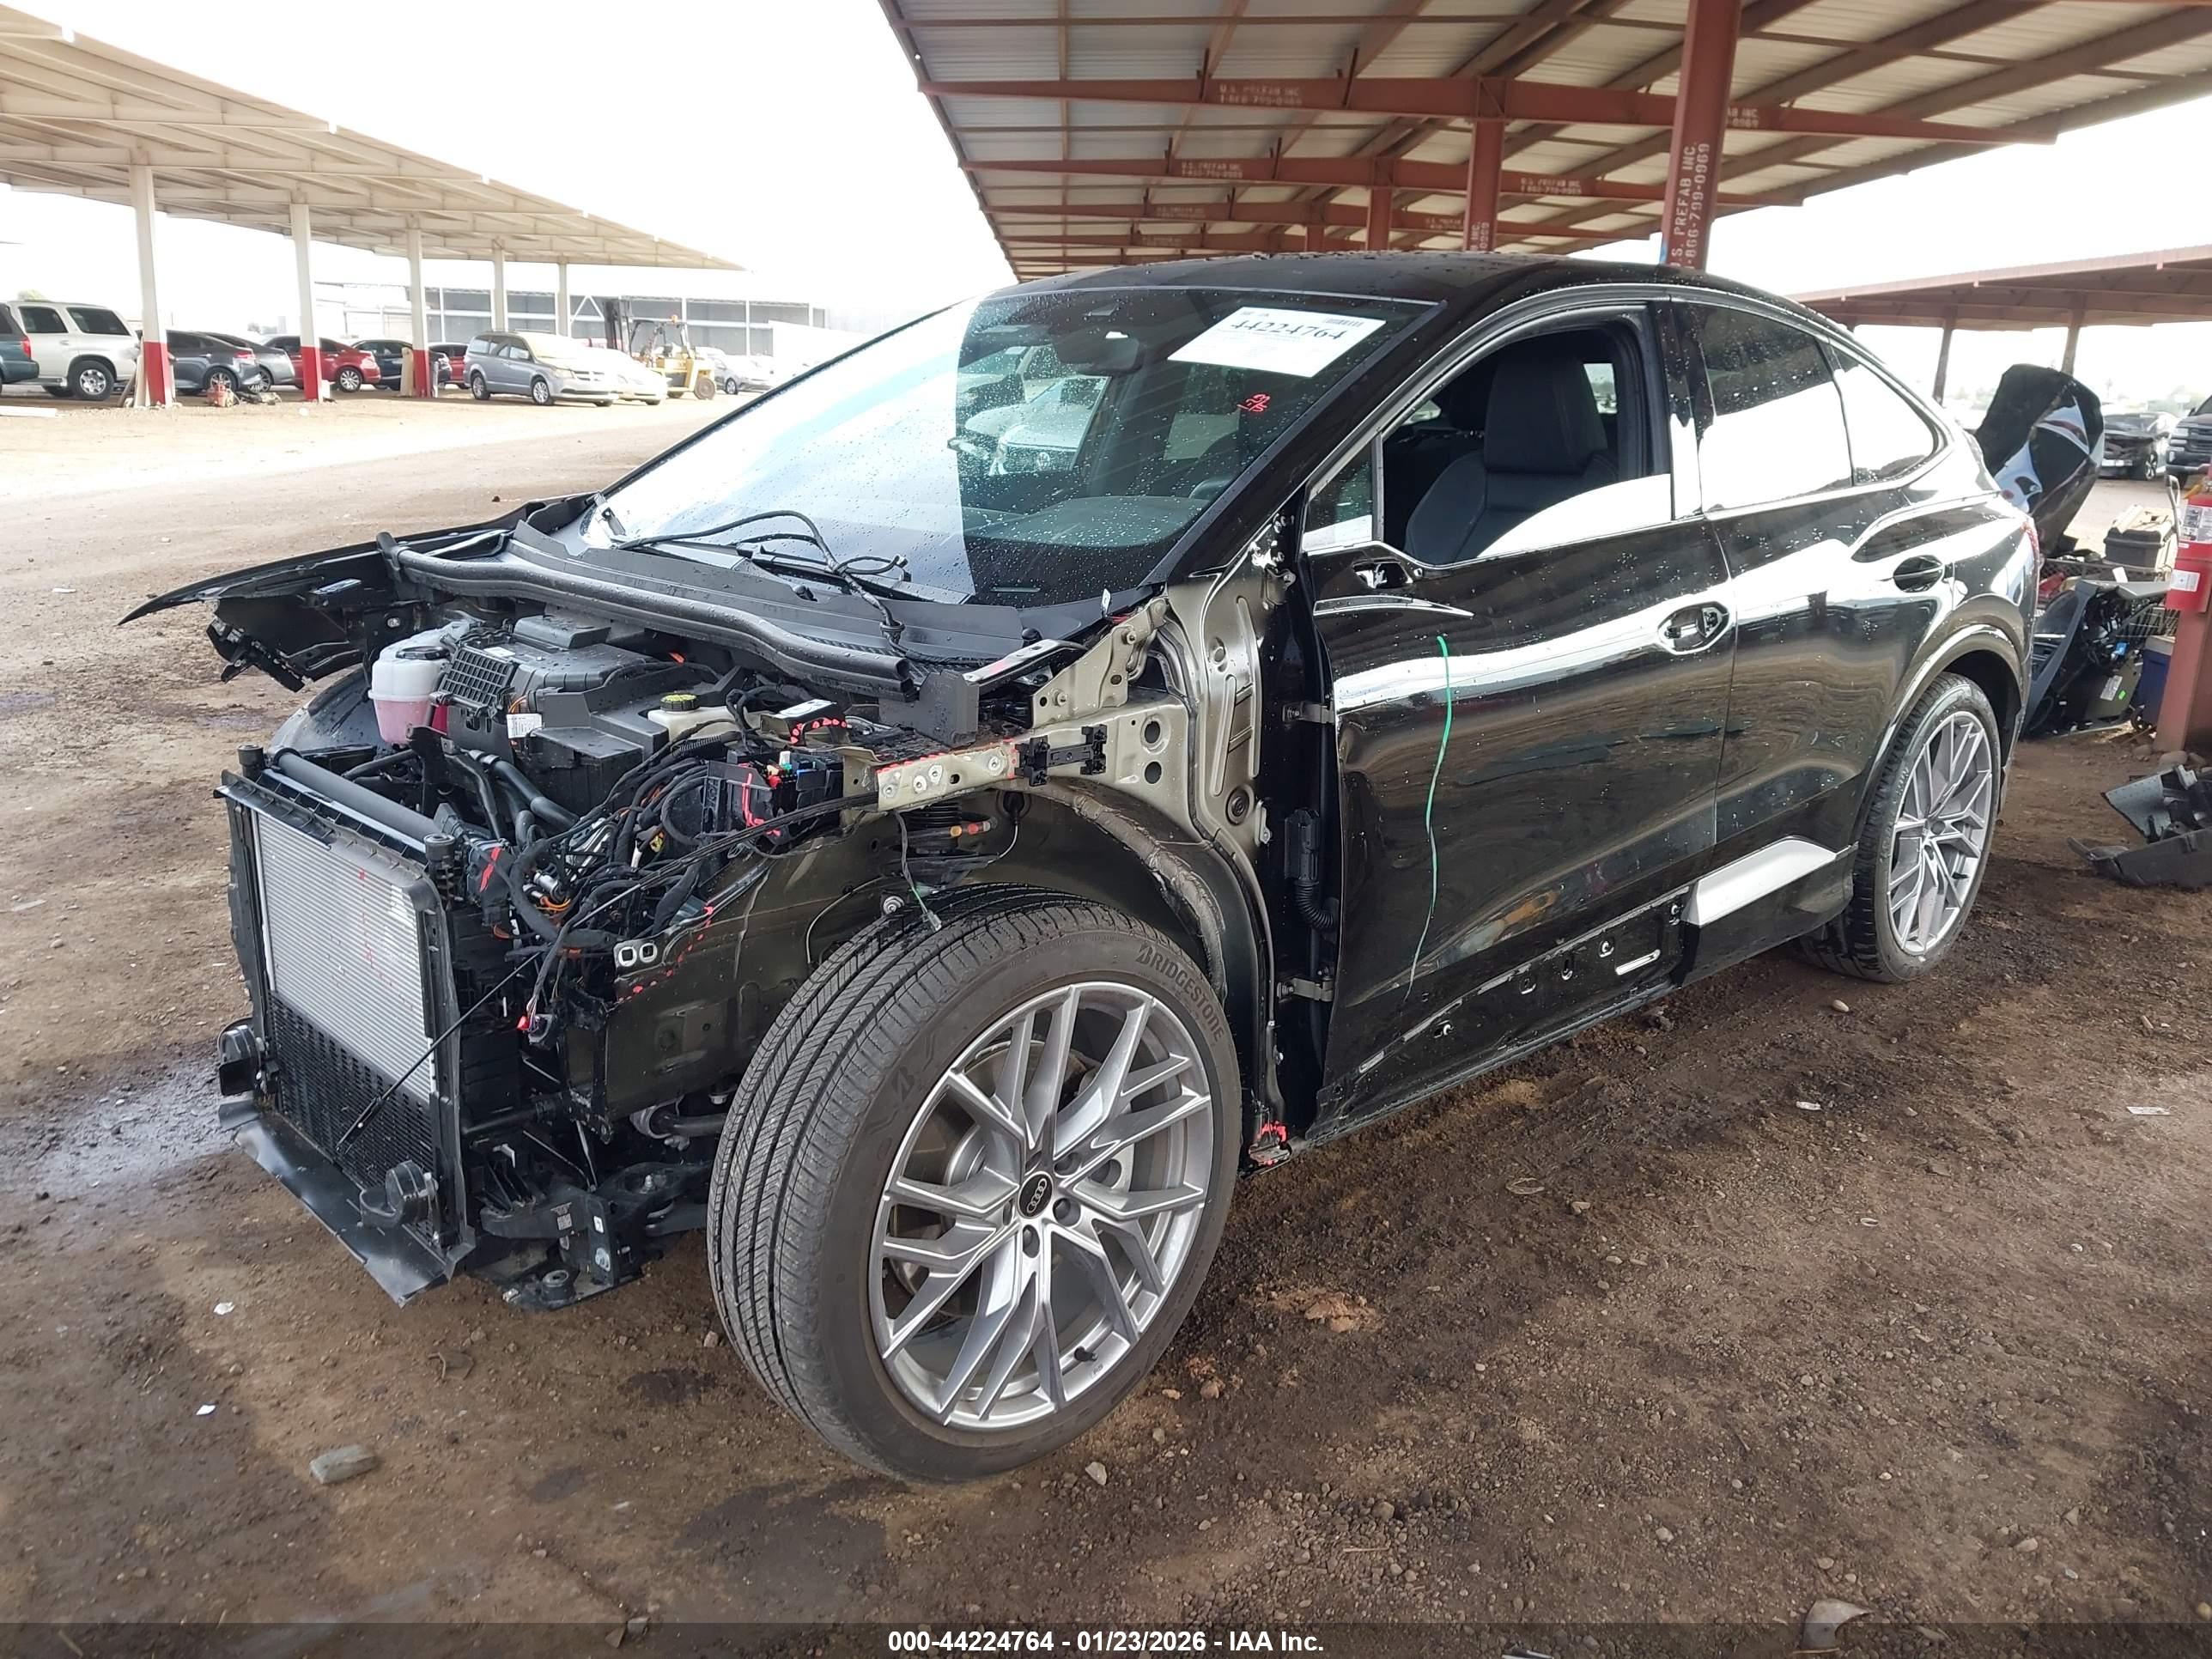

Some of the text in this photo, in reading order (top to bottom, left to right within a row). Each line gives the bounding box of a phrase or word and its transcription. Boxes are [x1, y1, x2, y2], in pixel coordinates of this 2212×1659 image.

[1674, 177, 1692, 236] PREFAB
[1231, 320, 1347, 339] 44224764
[1136, 944, 1224, 1042] BRIDGESTONE
